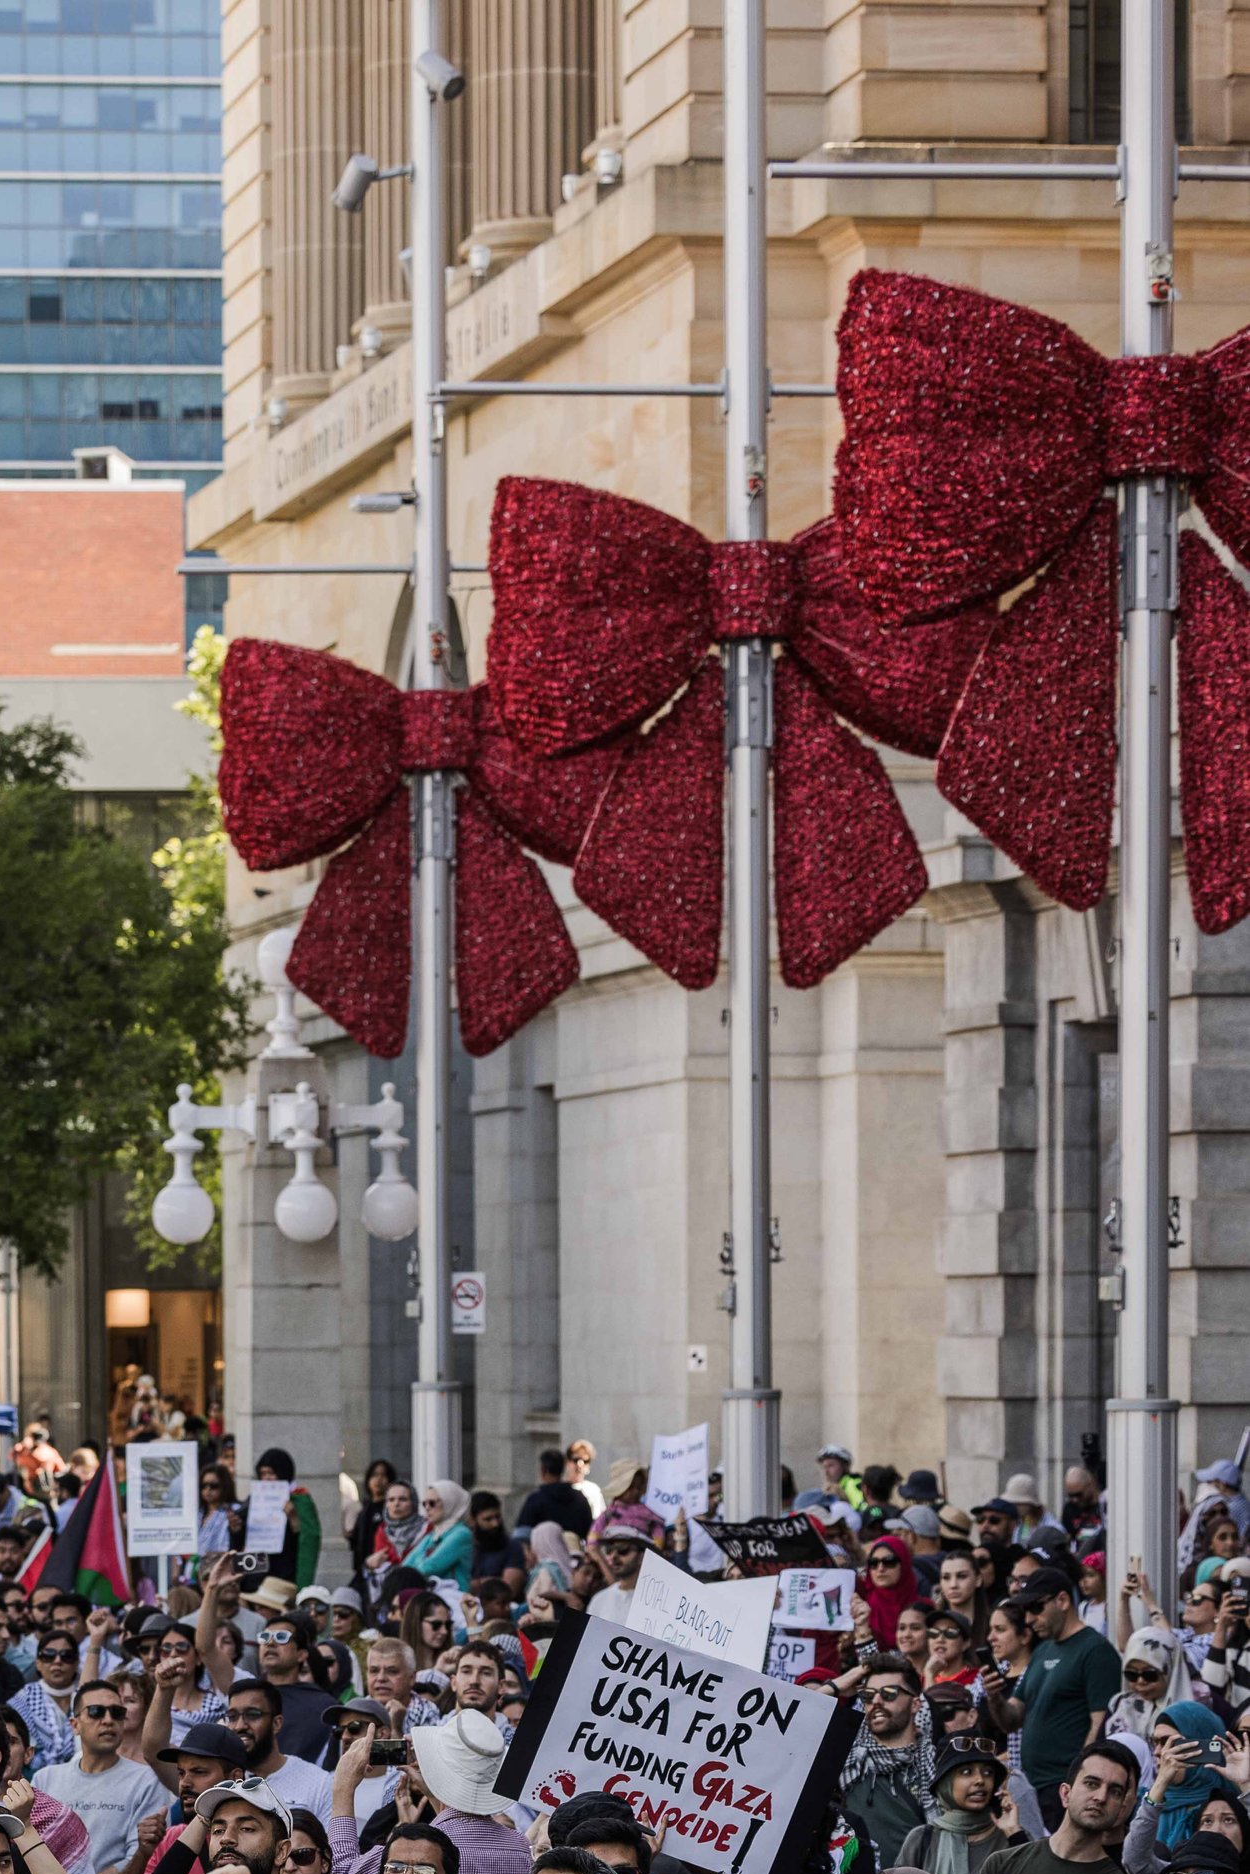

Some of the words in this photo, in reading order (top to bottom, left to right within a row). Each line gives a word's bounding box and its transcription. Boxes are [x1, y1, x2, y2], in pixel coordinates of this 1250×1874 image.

[747, 1540, 778, 1557] FOR
[768, 1517, 808, 1539] SIGN
[676, 1596, 733, 1647] BLACK-OUT
[602, 1636, 724, 1703] SHAME
[736, 1687, 800, 1736] ON
[682, 1711, 754, 1767] FOR
[568, 1721, 689, 1794] FUNDING
[693, 1761, 773, 1821] GAZA
[97, 1801, 125, 1812] Jeans
